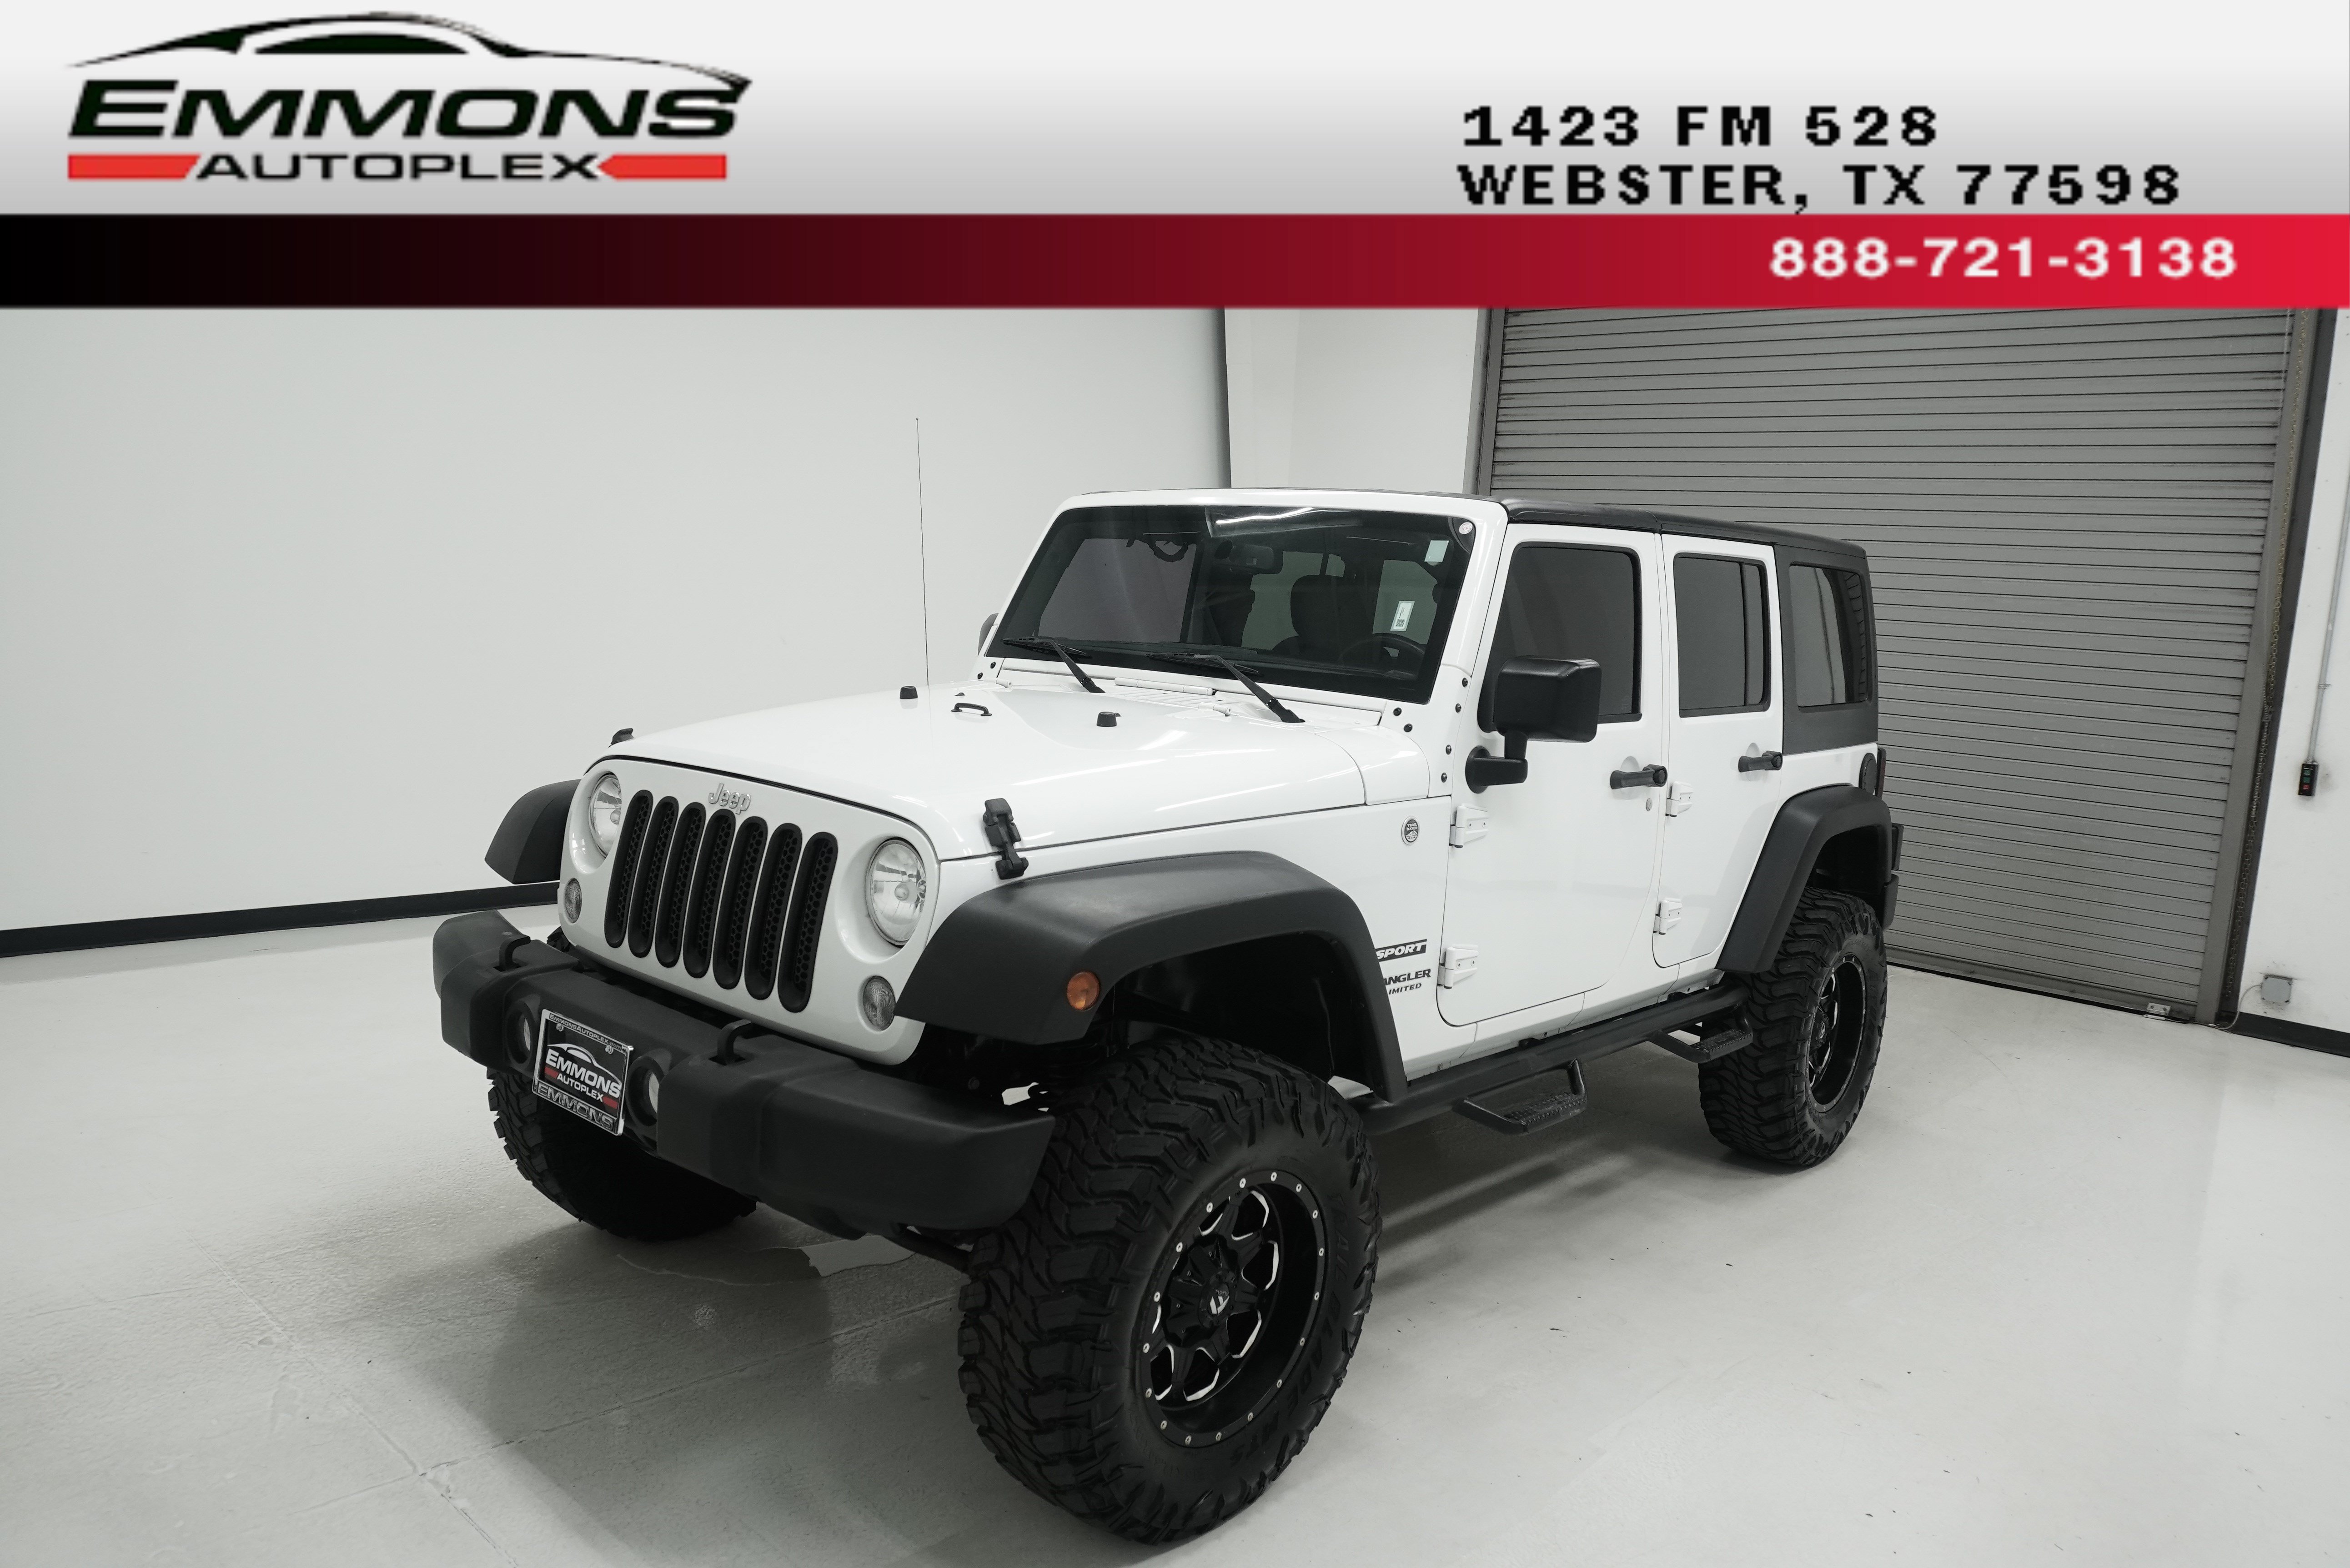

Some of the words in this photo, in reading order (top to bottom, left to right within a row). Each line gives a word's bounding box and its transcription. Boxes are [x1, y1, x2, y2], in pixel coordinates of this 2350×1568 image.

[708, 783, 751, 815] Jeep
[1376, 941, 1427, 960] SPORT
[546, 1048, 622, 1098] EMMONS
[557, 1073, 604, 1102] AUTOPLEX
[538, 1083, 613, 1131] EMMONS
